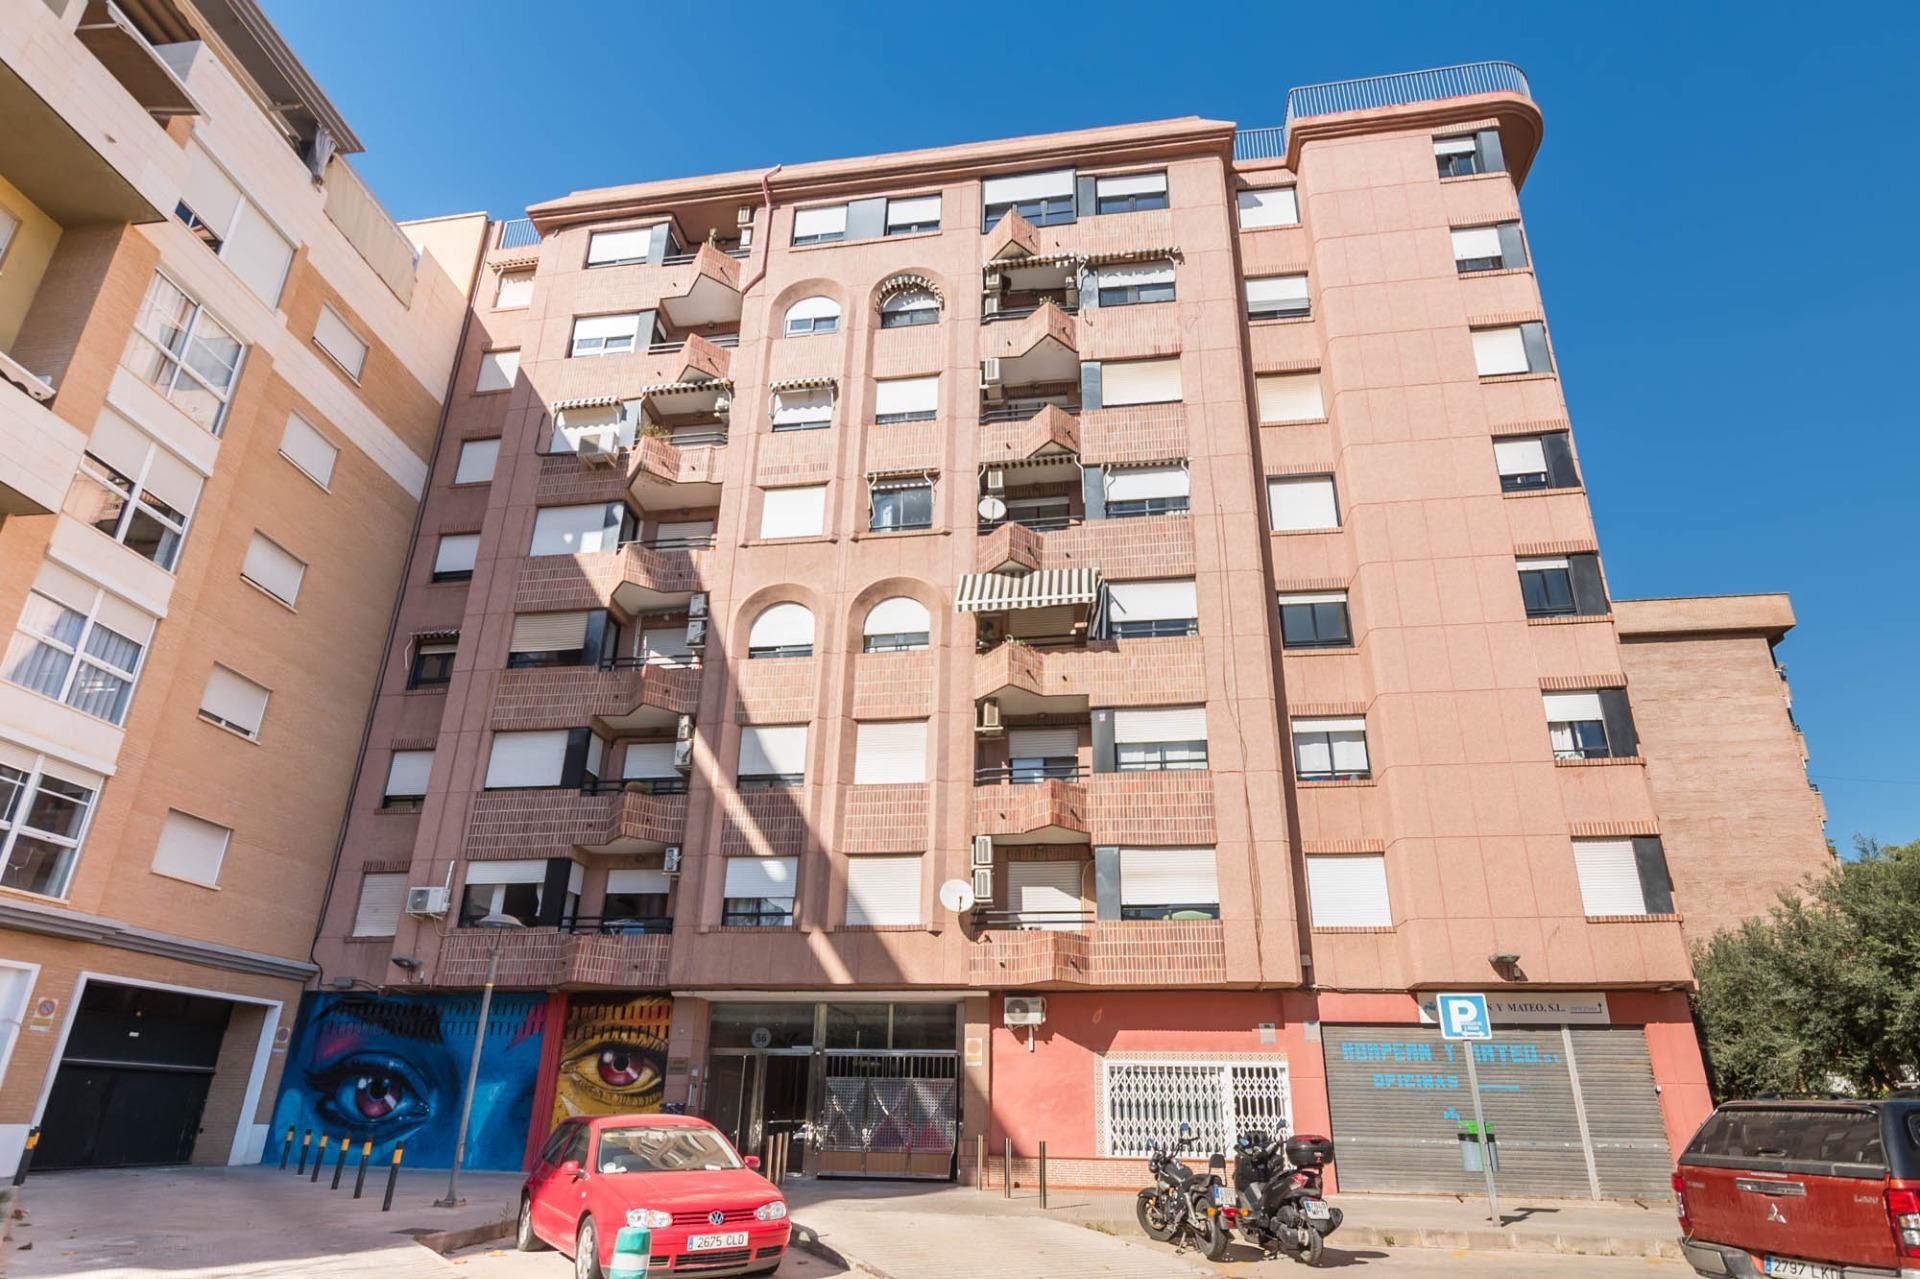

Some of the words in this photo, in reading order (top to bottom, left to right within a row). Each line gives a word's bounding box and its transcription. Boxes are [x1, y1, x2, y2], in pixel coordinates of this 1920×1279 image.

[1448, 999, 1477, 1032] P
[1496, 1003, 1503, 1012] Y
[1443, 1043, 1455, 1063] Y
[697, 1236, 722, 1248] 2675
[726, 1234, 745, 1246] CLD
[1774, 1259, 1806, 1276] 2797
